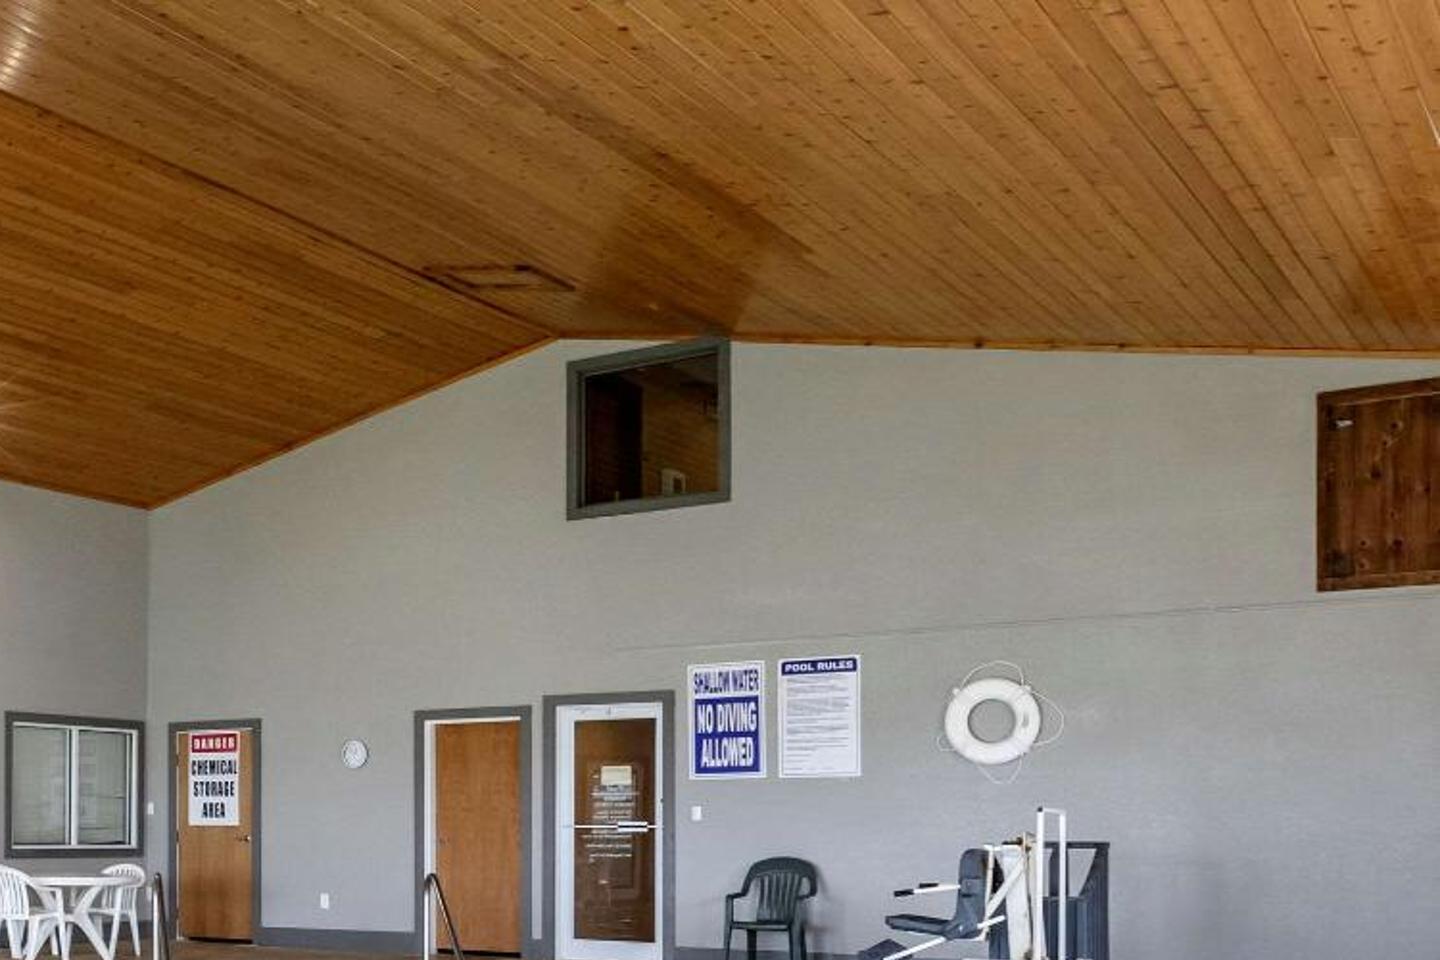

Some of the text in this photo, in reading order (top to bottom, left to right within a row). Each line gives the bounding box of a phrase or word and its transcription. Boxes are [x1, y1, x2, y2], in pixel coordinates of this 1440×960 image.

[784, 660, 854, 673] POOL RULES
[694, 669, 759, 694] SHALLOW WATER
[697, 701, 757, 734] NO DIVING
[193, 737, 235, 749] DANGER
[700, 737, 754, 768] ALLOWED
[191, 759, 238, 775] CHEMICAL
[193, 781, 235, 797] STORAGE
[202, 802, 225, 818] AREA
